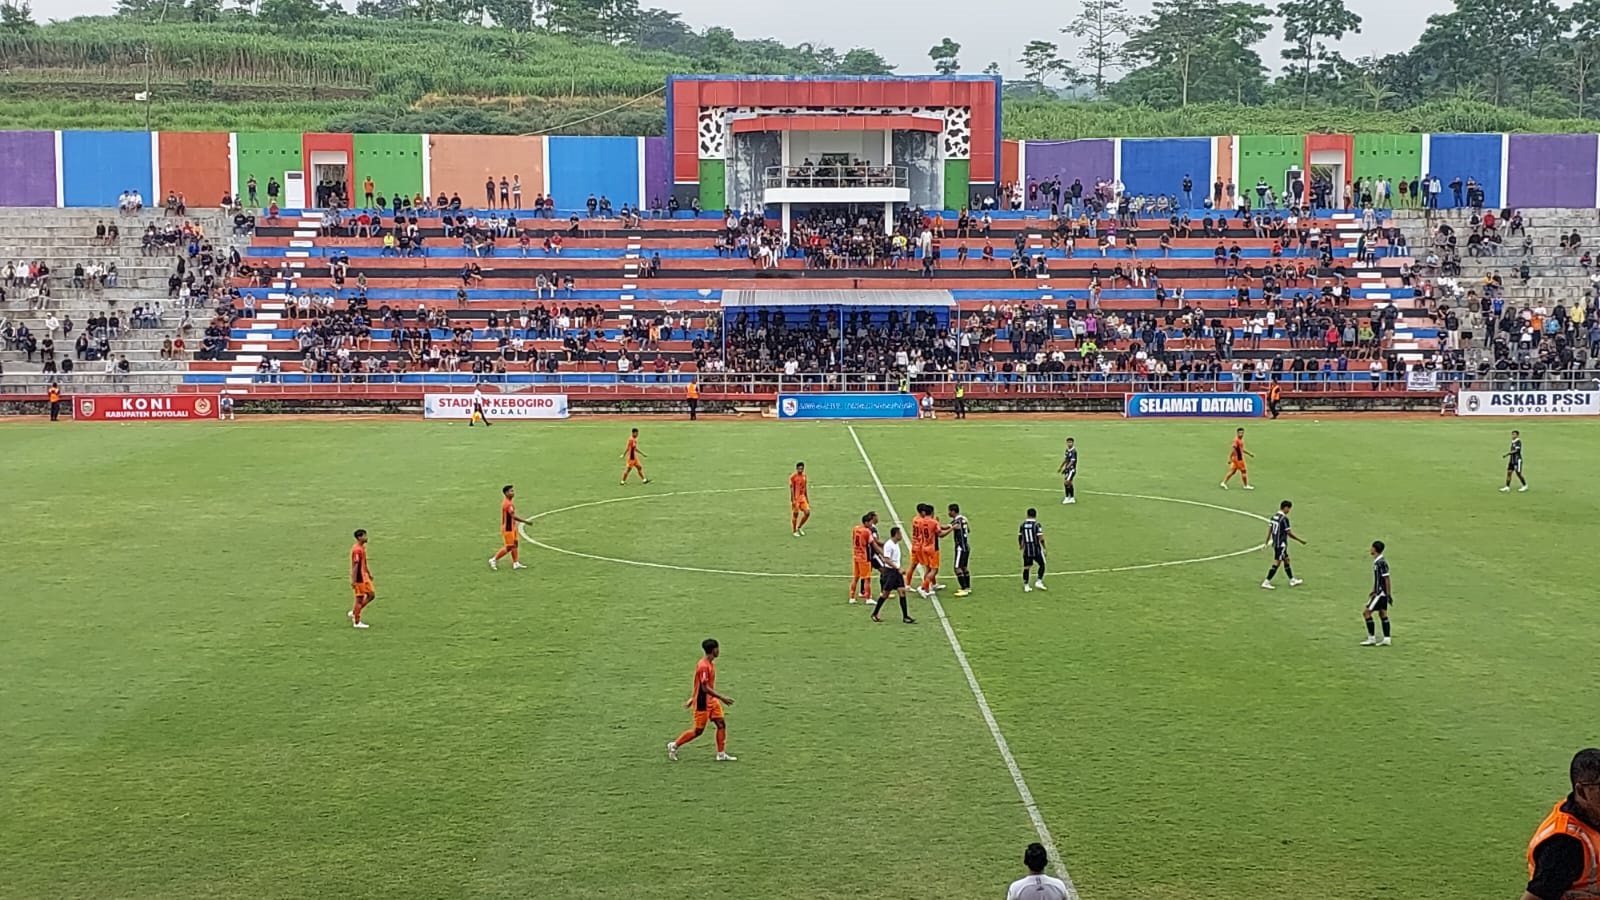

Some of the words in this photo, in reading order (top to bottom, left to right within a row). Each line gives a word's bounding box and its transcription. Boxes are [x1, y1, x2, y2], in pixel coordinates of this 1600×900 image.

[122, 398, 172, 410] KONI
[438, 398, 490, 408] STADIN
[493, 398, 554, 408] KEBOGIRO
[1139, 397, 1199, 412] SELAMAT
[1201, 397, 1253, 412] DATANG
[1490, 393, 1547, 406] ASKAB
[1552, 393, 1591, 406] PSSI
[151, 410, 189, 418] BOYOLALI
[1024, 528, 1034, 542] 11
